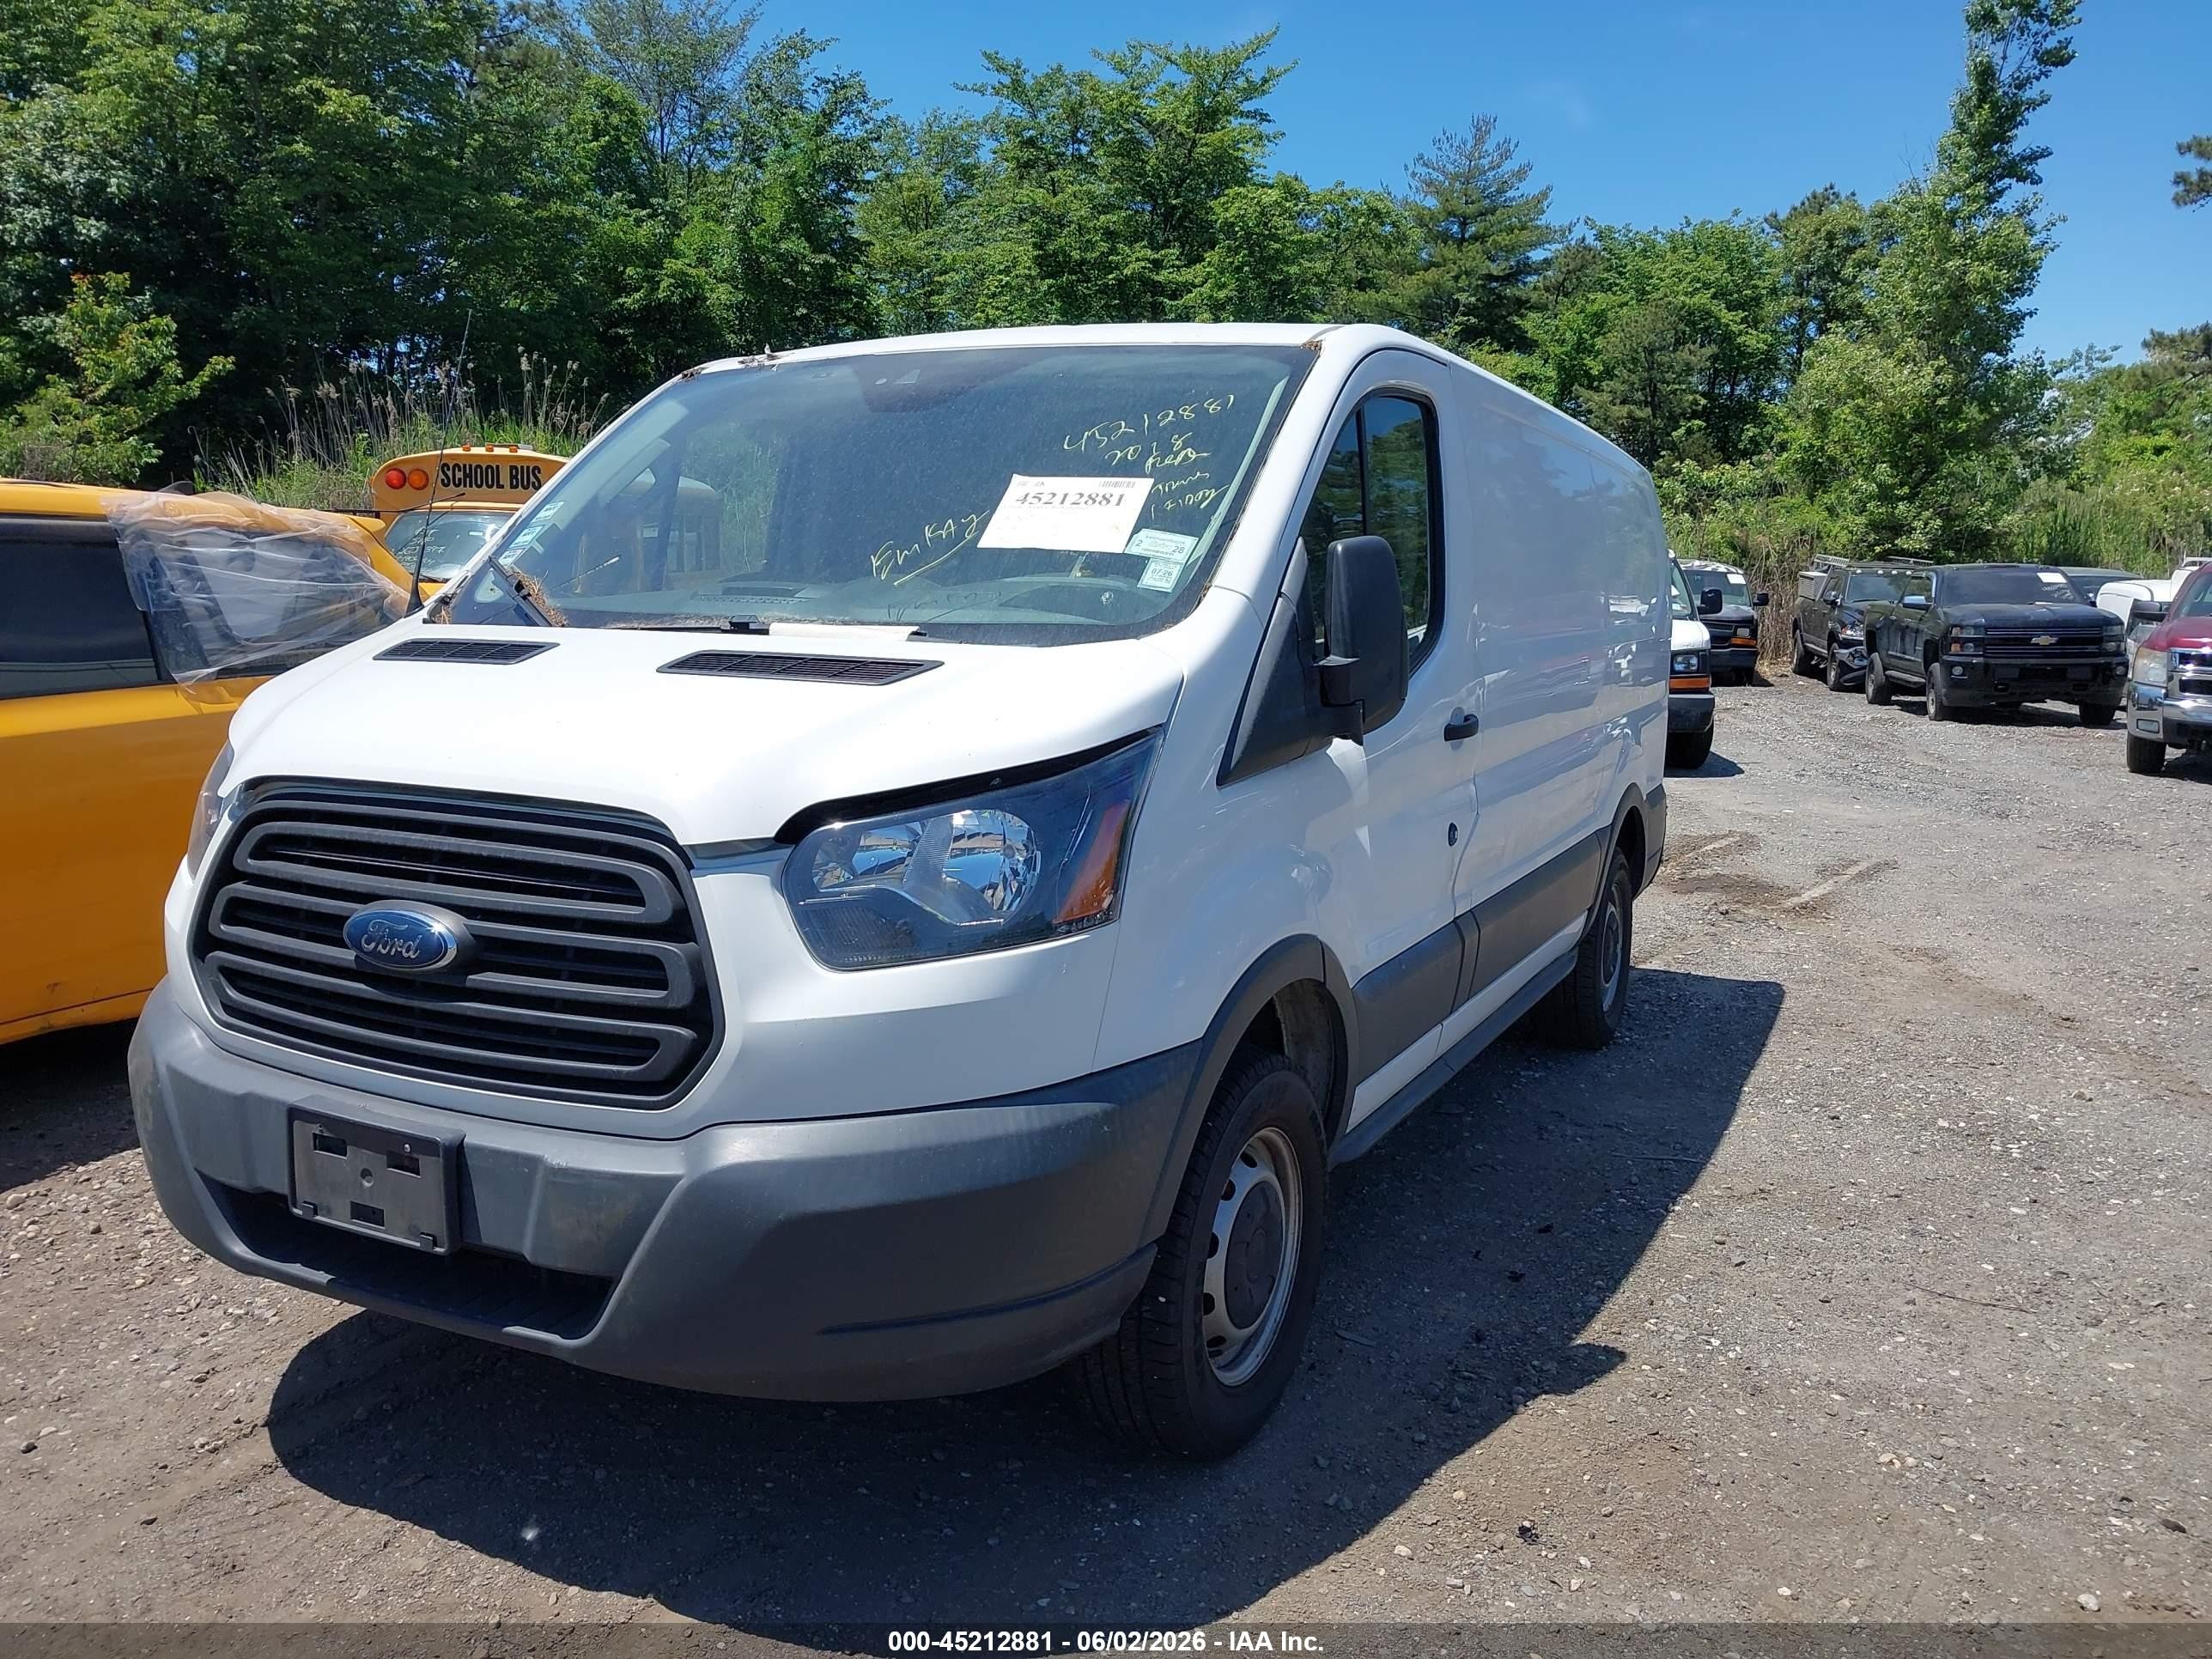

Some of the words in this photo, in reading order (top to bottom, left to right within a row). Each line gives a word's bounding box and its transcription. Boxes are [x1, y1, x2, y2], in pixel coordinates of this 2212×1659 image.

[440, 462, 505, 489] SCHOOL
[509, 465, 542, 490] BUS
[1015, 492, 1125, 507] 45212881
[361, 919, 423, 959] Ford
